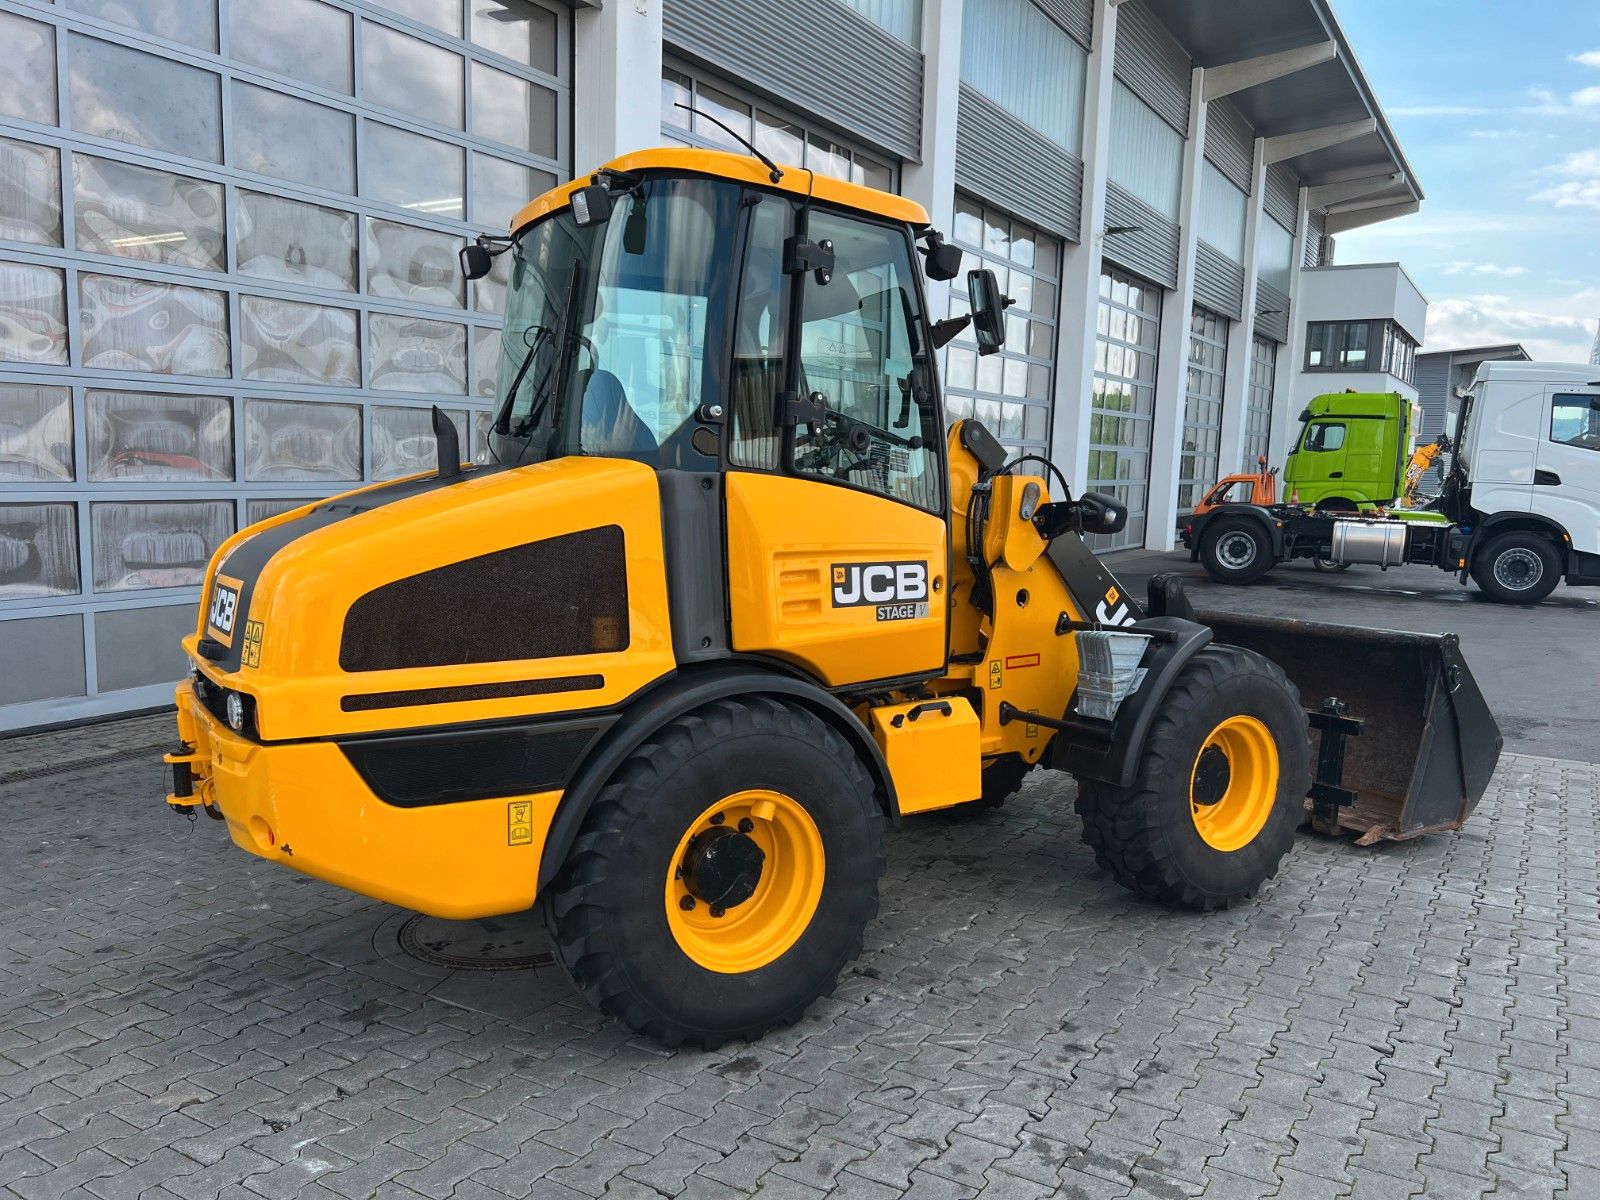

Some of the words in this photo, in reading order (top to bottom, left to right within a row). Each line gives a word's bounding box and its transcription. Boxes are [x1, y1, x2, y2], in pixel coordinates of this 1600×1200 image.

[834, 565, 926, 603] JCB
[211, 587, 236, 631] JCB
[877, 605, 914, 620] STAGE
